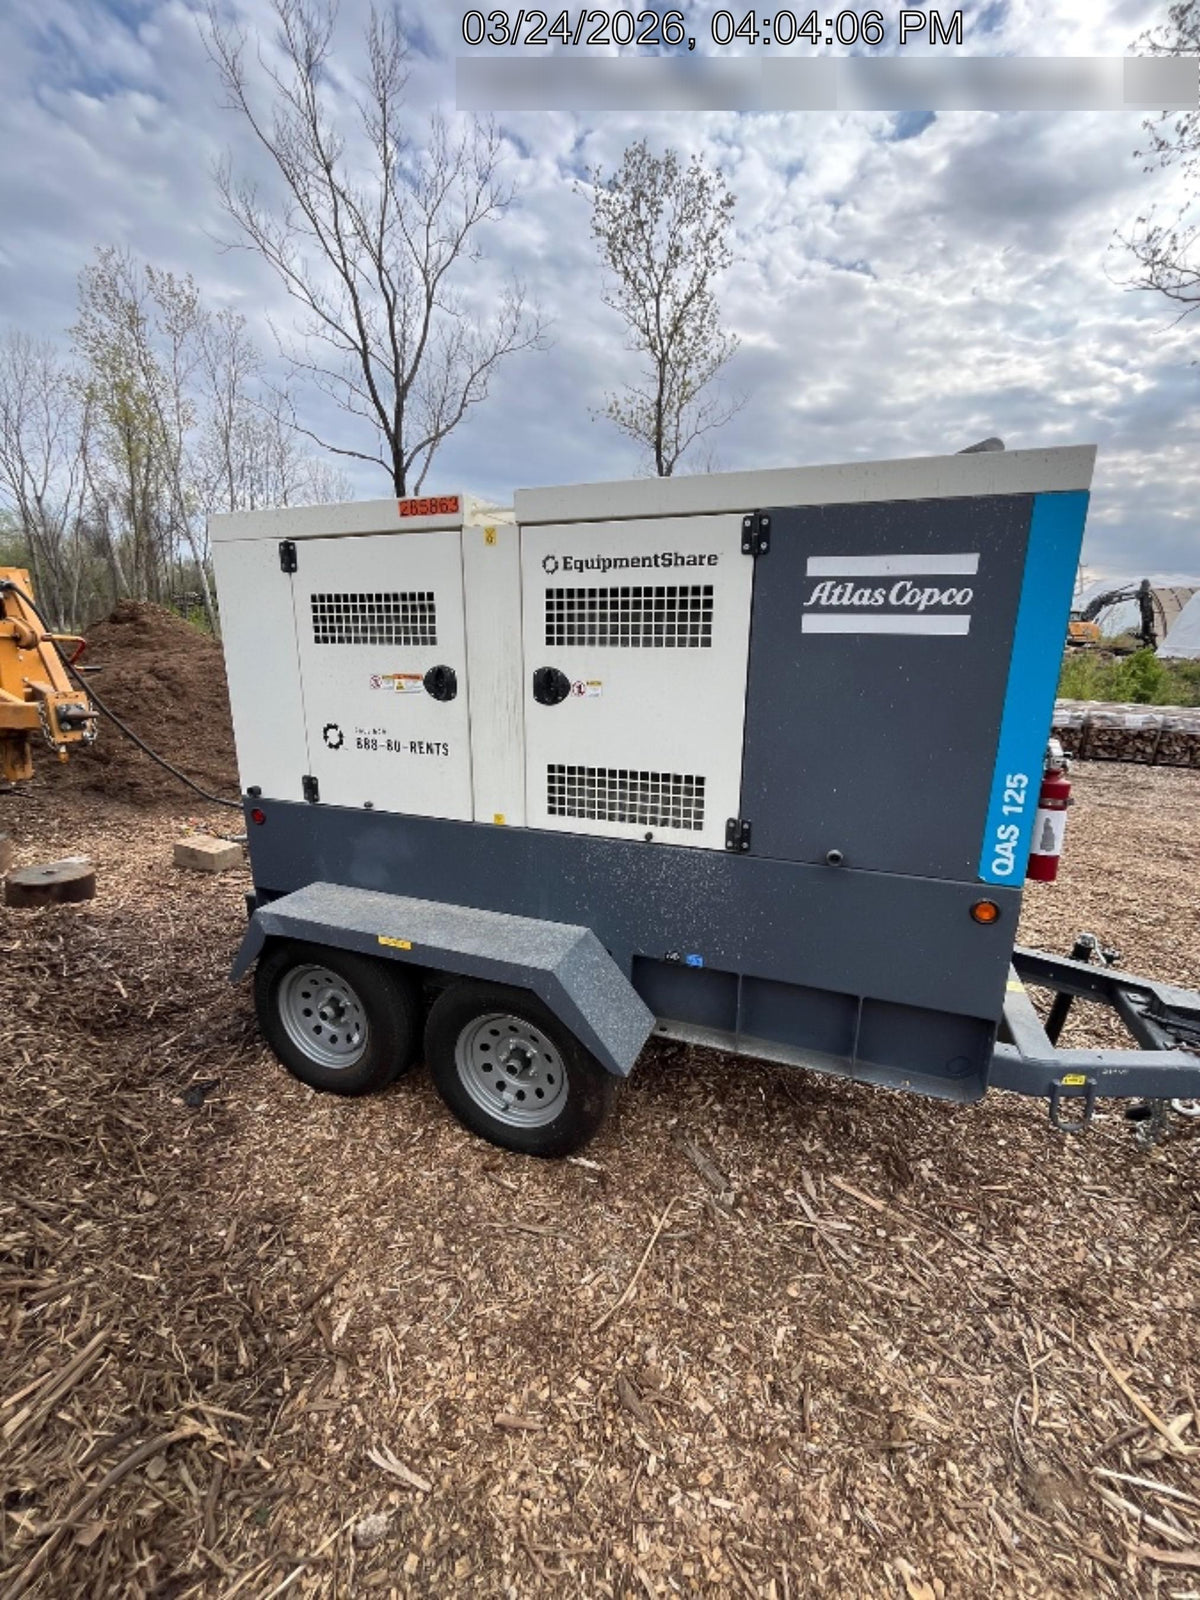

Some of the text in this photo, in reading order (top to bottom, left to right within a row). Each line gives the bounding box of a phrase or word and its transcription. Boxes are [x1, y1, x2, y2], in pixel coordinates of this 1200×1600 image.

[562, 552, 718, 573] EquipmentShare
[803, 581, 973, 612] Atlas Copco
[992, 773, 1029, 876] QAS 125
